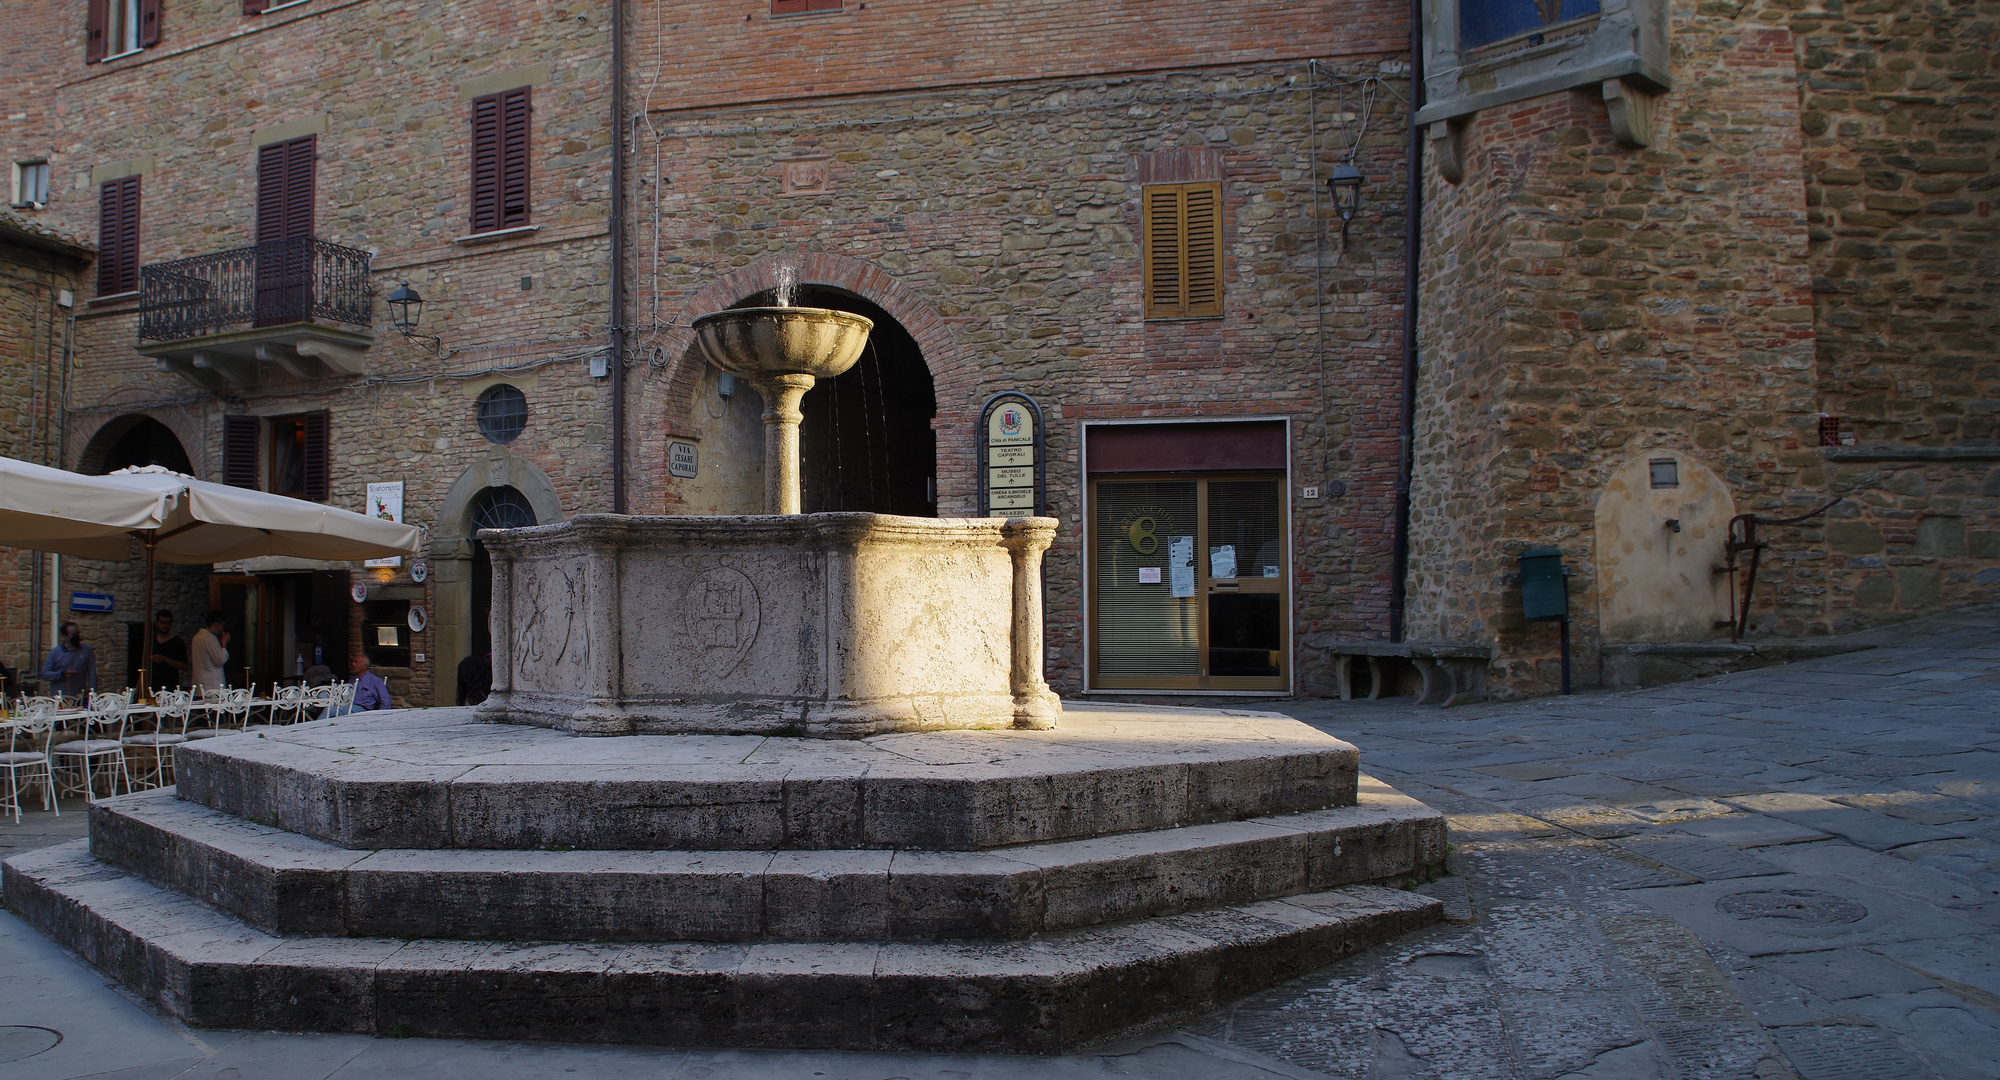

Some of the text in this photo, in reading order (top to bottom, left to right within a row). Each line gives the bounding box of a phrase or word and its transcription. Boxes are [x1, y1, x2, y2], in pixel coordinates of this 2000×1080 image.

[678, 446, 690, 454] VIA
[675, 454, 693, 463] CESARE
[671, 462, 697, 472] CAPORALI
[369, 484, 401, 493] Ristorante
